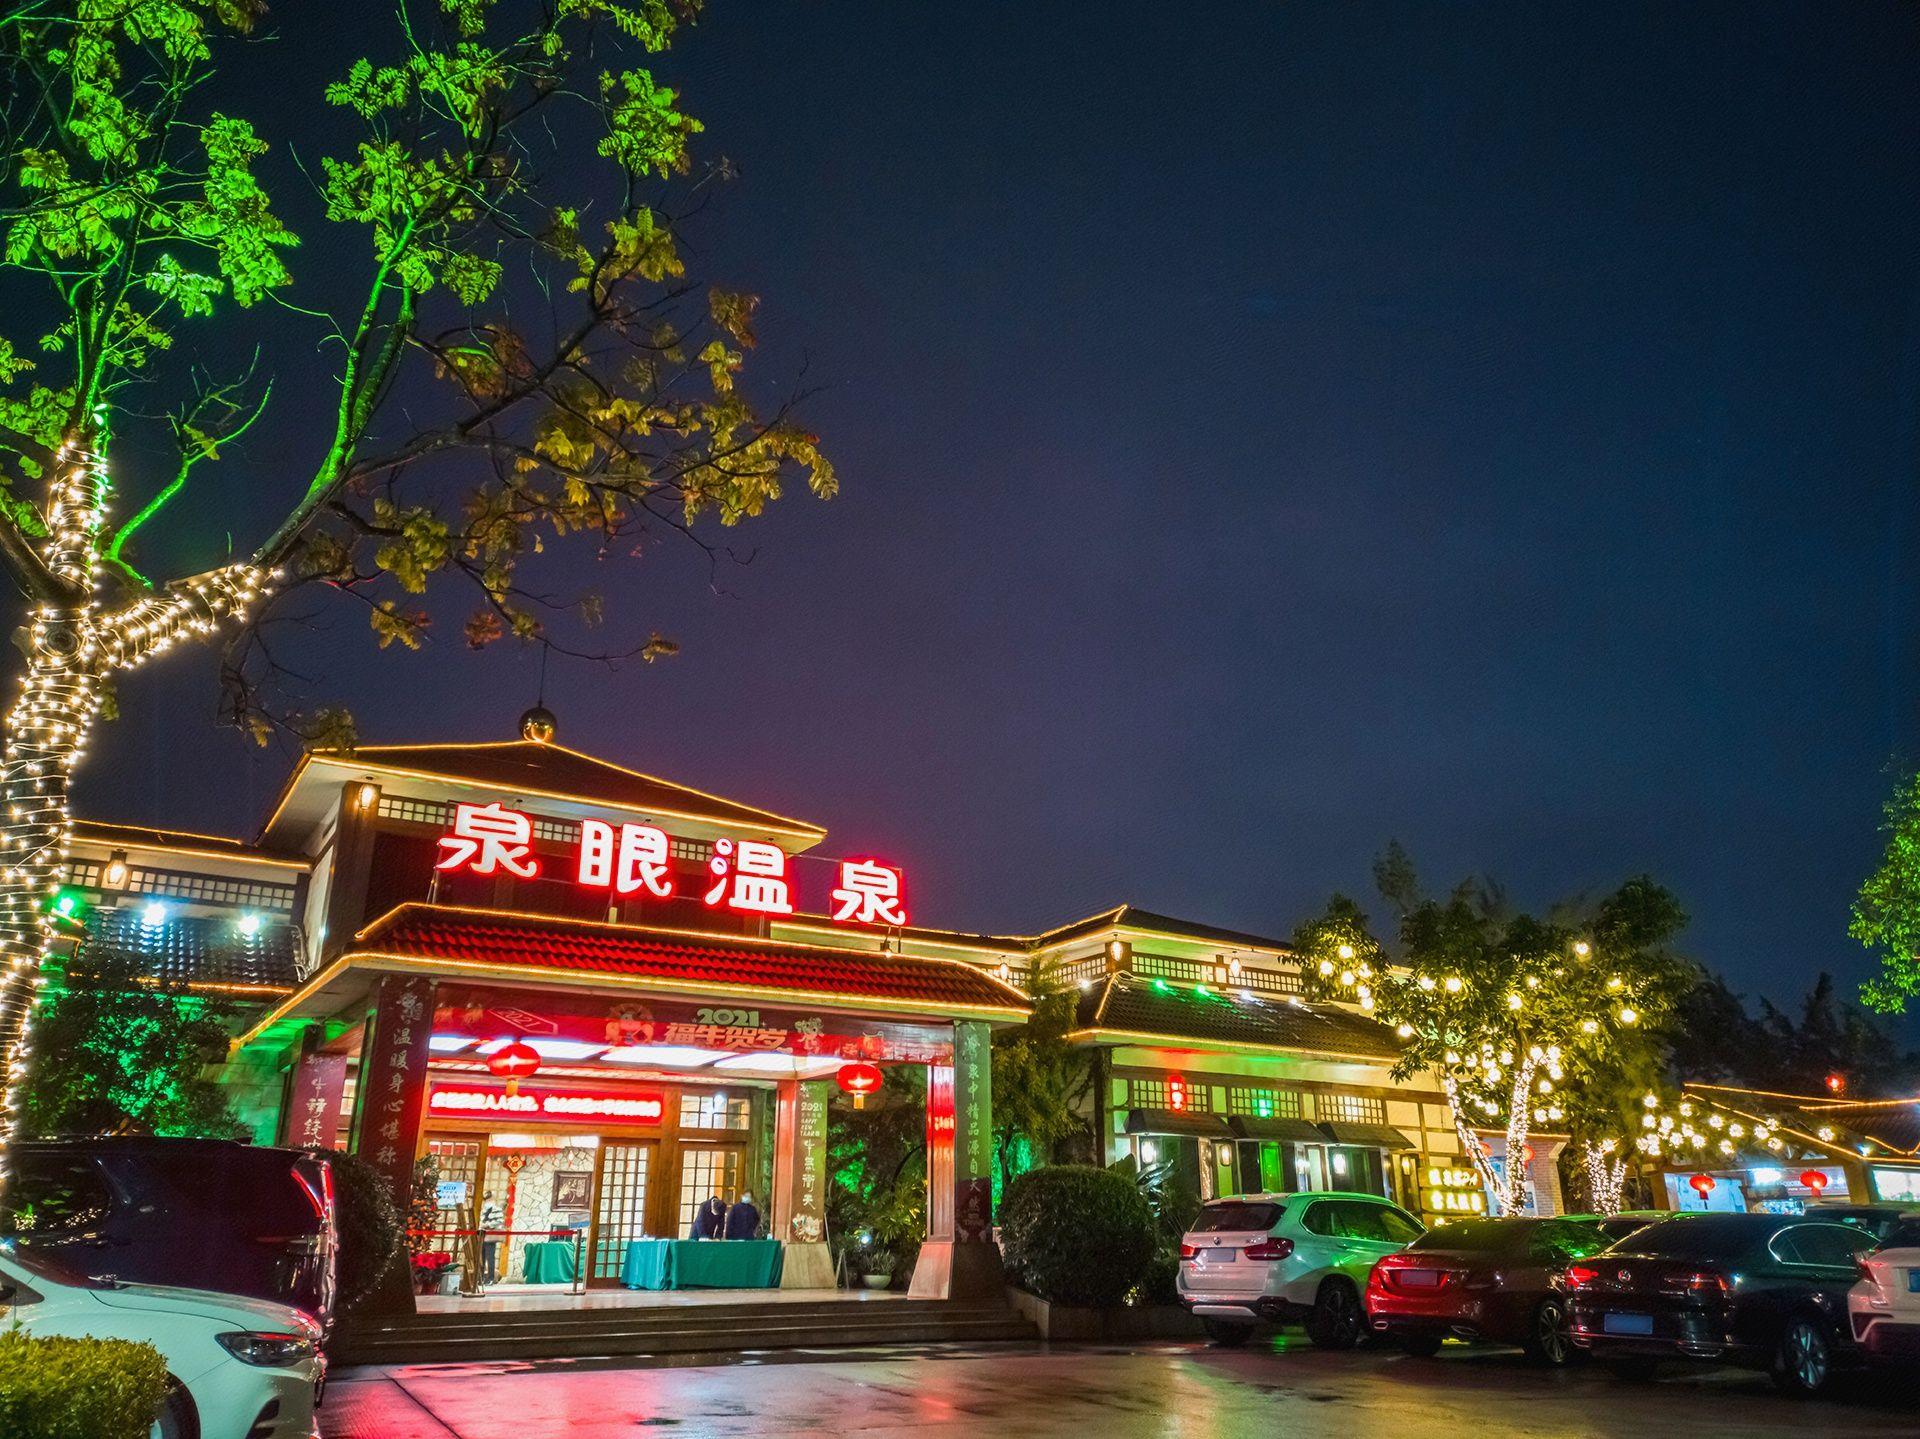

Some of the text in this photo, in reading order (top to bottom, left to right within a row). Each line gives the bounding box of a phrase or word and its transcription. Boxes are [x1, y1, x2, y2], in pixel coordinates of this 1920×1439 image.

[435, 802, 906, 926] 泉眼温泉
[697, 1008, 760, 1028] 2021
[664, 1022, 789, 1050] 福牛贺岁
